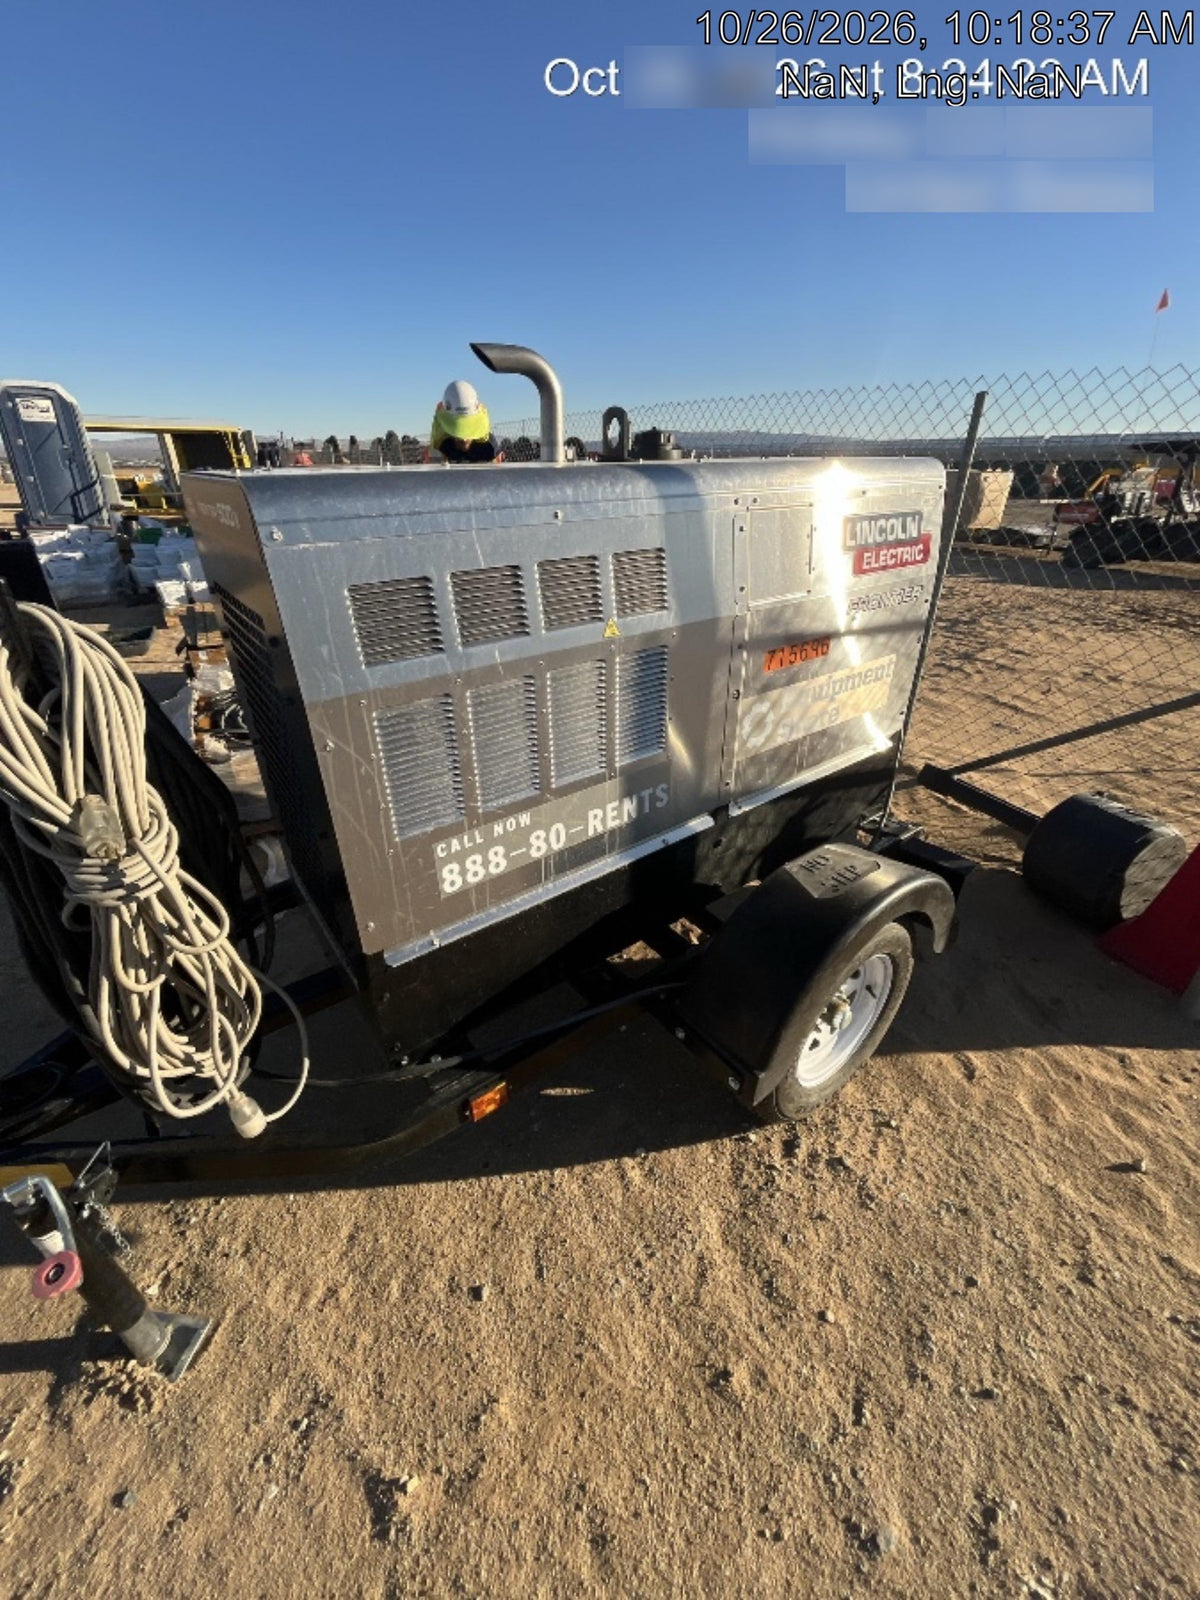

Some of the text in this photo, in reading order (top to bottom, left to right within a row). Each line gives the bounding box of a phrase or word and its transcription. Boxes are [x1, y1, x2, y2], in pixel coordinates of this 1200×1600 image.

[845, 514, 920, 547] LINCOLN
[862, 543, 924, 570] ELECTRIC
[806, 659, 897, 707] uipment
[436, 811, 532, 858] CALL NOW
[441, 783, 670, 894] 888-80-RENTS
